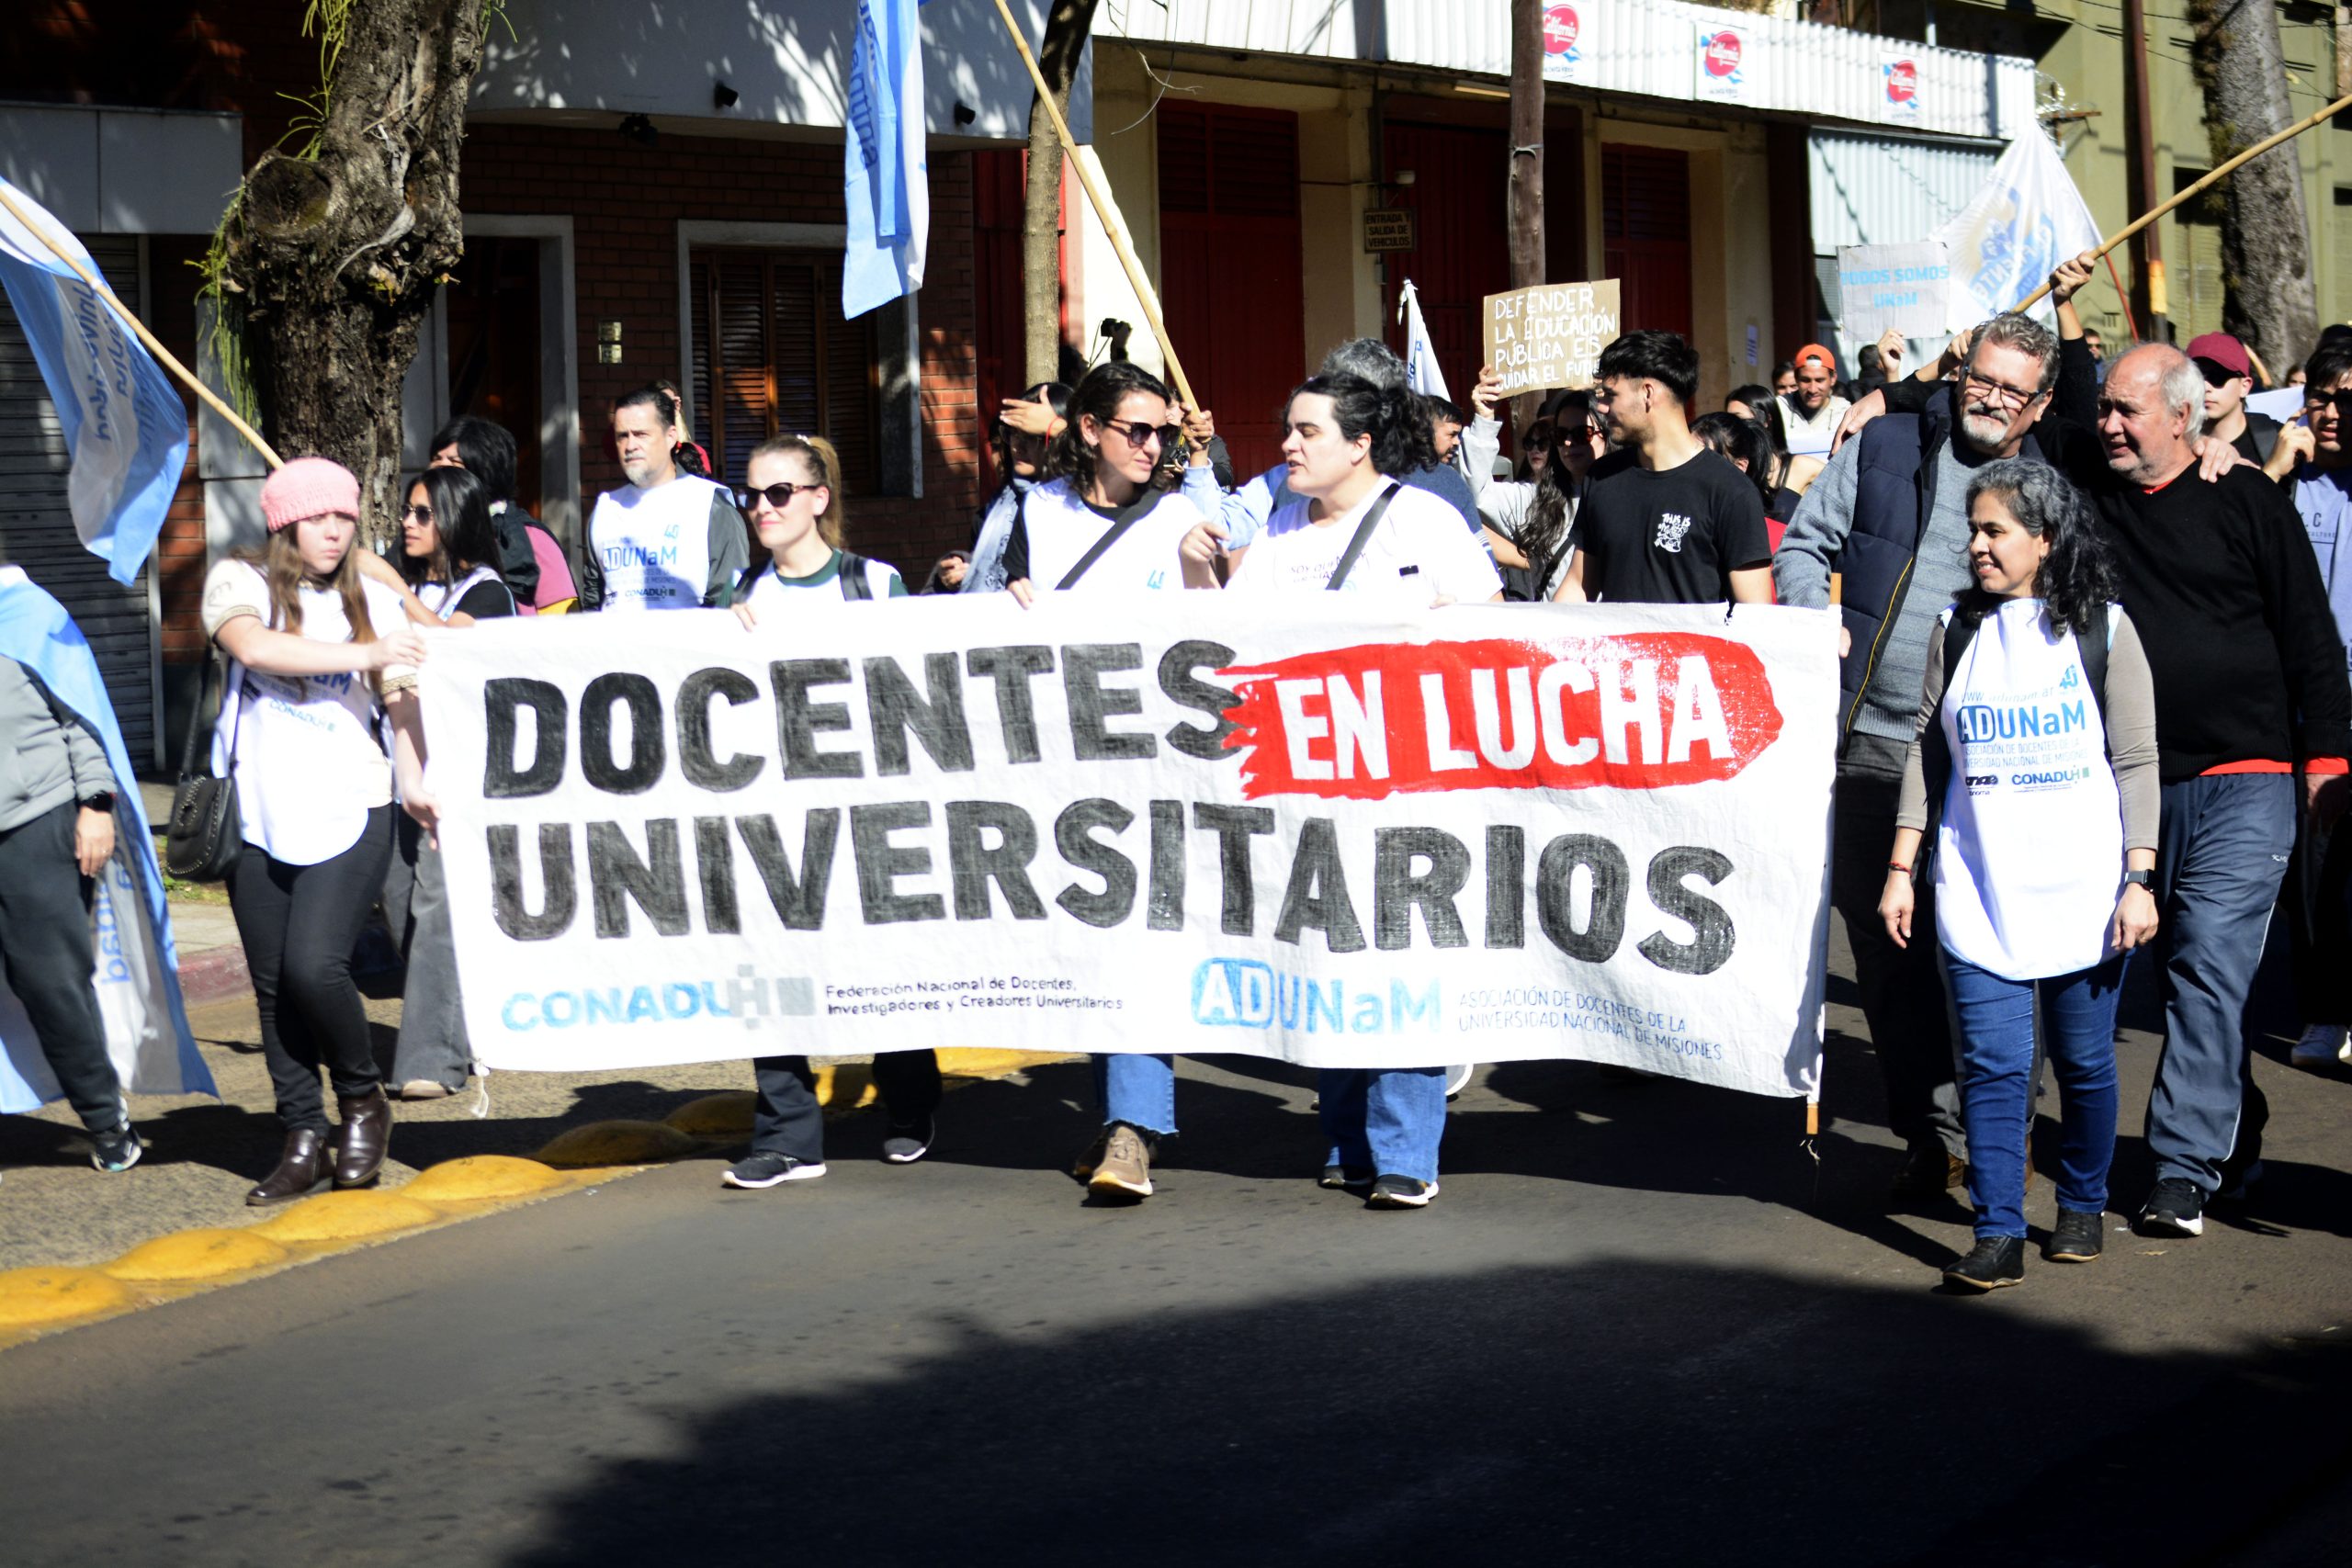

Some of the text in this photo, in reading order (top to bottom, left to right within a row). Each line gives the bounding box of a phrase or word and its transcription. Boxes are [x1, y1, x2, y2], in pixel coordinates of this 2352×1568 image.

[1365, 212, 1403, 225] ENTRADA
[1368, 224, 1408, 236] SALIDA DE
[1368, 236, 1410, 247] VEHICULOS
[1894, 265, 1950, 283] SOMOS
[1496, 287, 1594, 320] DEFENDER
[1495, 307, 1615, 344] LA EDUCACIÓN
[1496, 335, 1602, 371] PÚBLICA ES
[1544, 365, 1560, 383] EL
[1662, 513, 1681, 524] THIS
[483, 640, 1736, 799] DOCENTES EN LUCHA
[1956, 699, 2086, 744] ADUNaM
[2007, 743, 2016, 754] DE
[2018, 741, 2057, 753] DOCENTES
[2003, 756, 2039, 767] NACIONAL
[486, 797, 1736, 976] UNIVERSITARIOS
[825, 981, 913, 998] Federación
[917, 976, 984, 994] Nacional
[989, 976, 1006, 990] de
[1191, 957, 1441, 1034] ADUNaM
[828, 994, 1124, 1016] Investigadores y Creadores Universitarios
[1459, 986, 1686, 1032] ASOCIACIÓN DE DOCENTES DE LA
[1459, 1011, 1723, 1060] UNIVERSIDAD NACIONAL DE MISIONES
